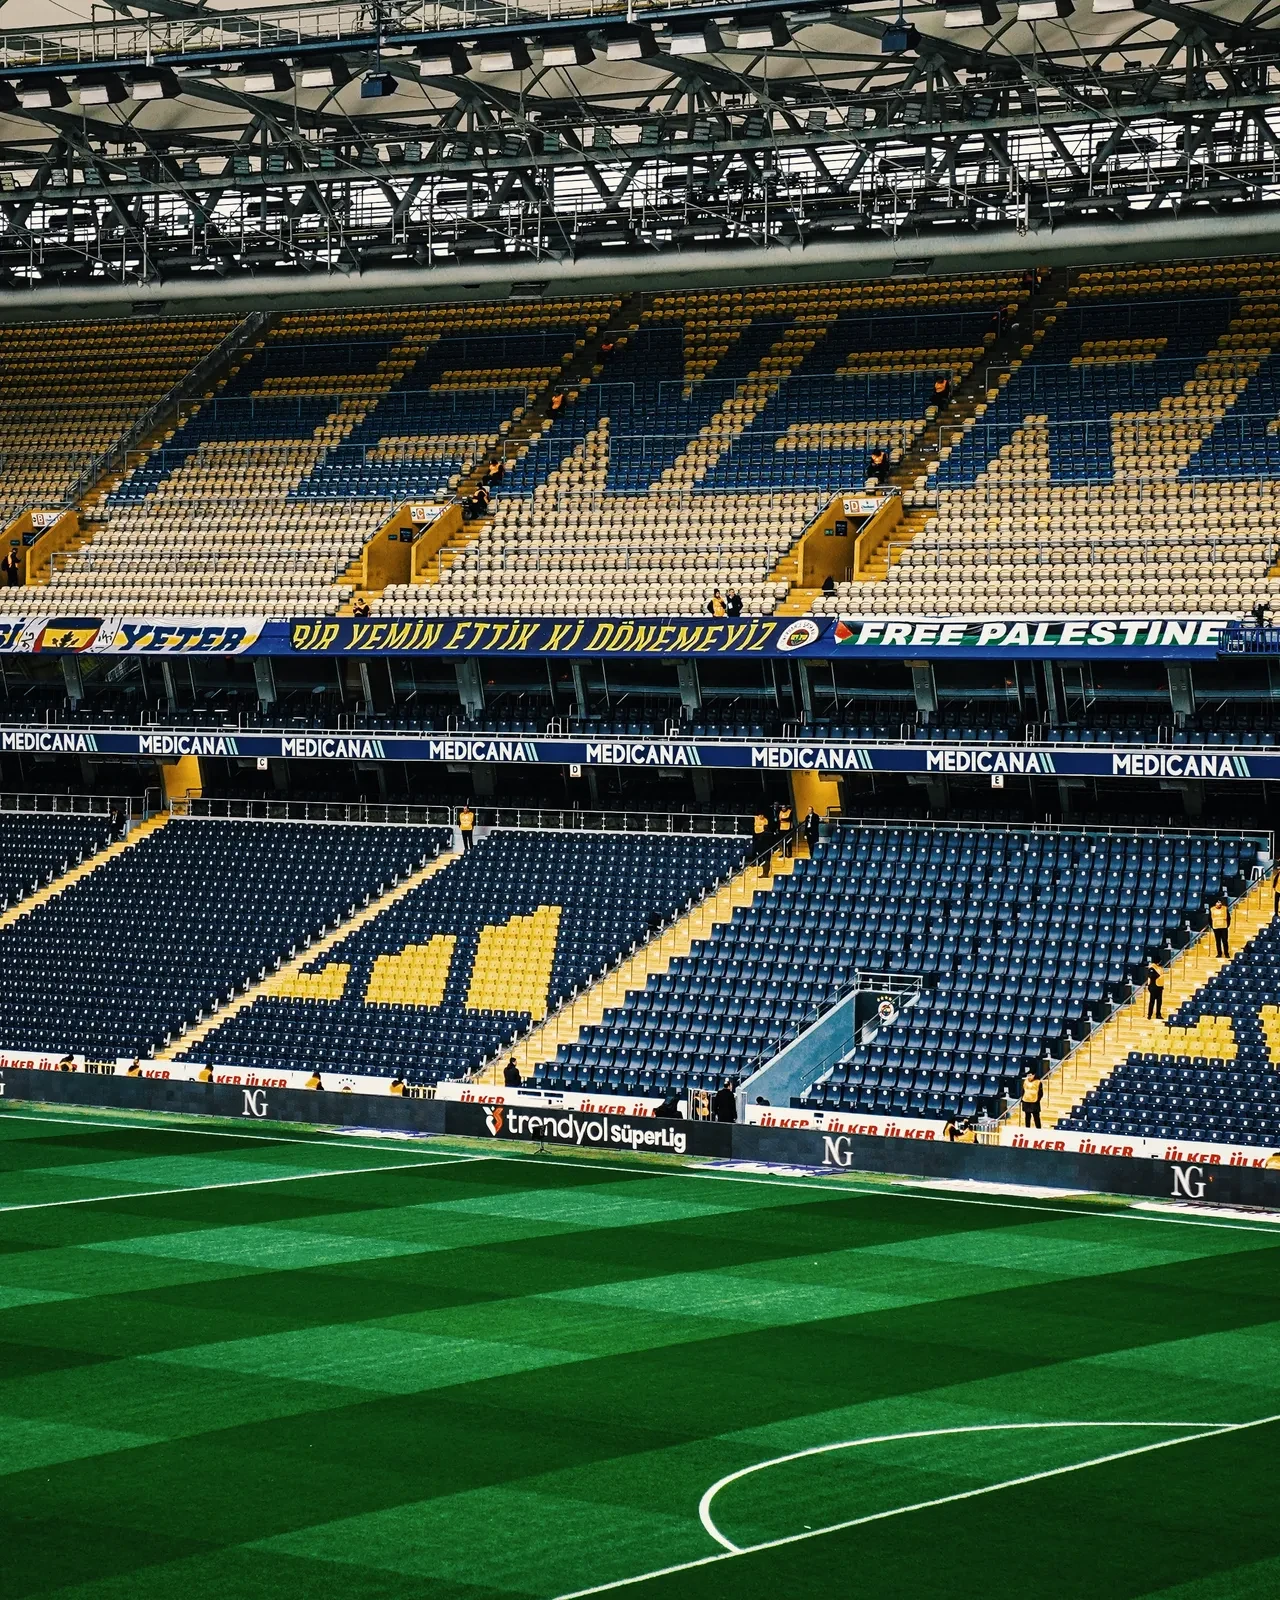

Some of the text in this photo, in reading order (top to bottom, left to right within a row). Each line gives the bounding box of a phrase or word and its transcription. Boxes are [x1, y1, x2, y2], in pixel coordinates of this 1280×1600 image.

[118, 625, 247, 651] YETER
[292, 620, 340, 650] BİR
[343, 619, 443, 650] YEMİN
[443, 619, 540, 650] ETTİK
[539, 619, 585, 651] Kİ
[583, 619, 778, 651] DÖNEMEYİZ
[855, 621, 1228, 646] FREE PALESTINE
[2, 732, 1235, 777] MEDICANA MEDICANA MEDICANA MEDICANA MEDICANA MEDICANA MEDICANA MEDICANA
[259, 758, 265, 766] C
[572, 765, 579, 773] D
[994, 775, 1000, 784] E
[506, 1108, 608, 1145] trendyol
